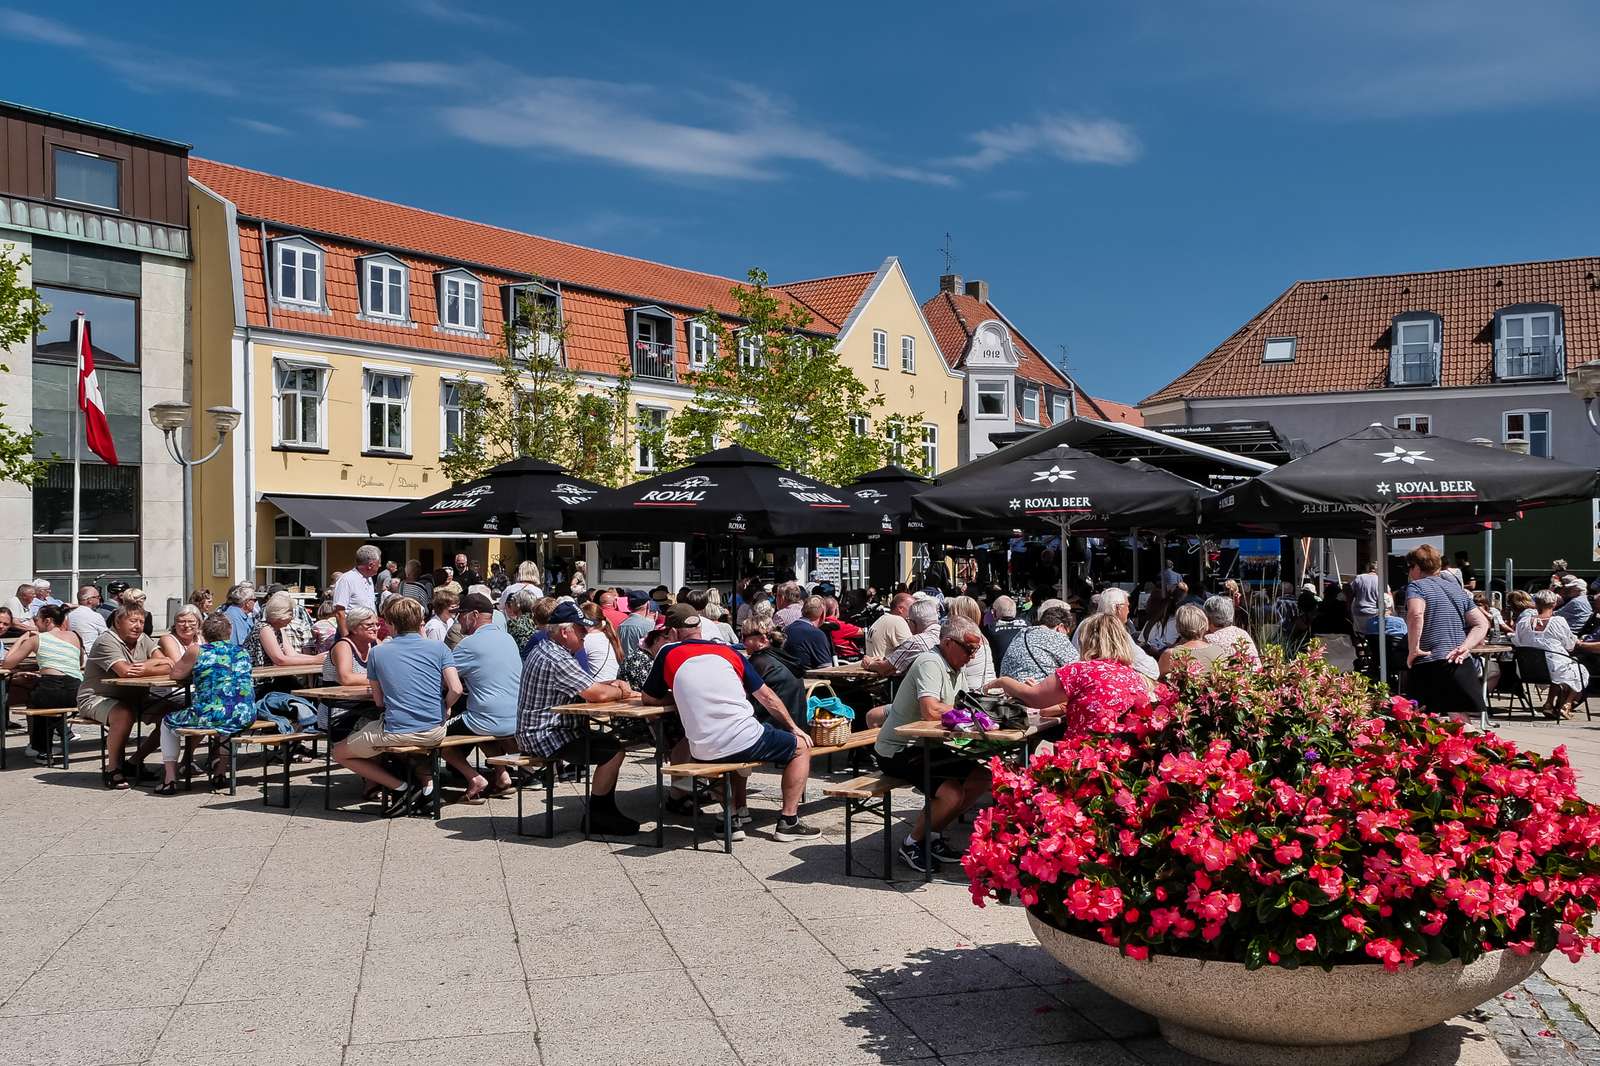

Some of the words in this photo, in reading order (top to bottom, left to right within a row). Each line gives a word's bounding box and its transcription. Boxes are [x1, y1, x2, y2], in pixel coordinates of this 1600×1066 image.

[983, 349, 1000, 359] 1912
[1395, 481, 1439, 493] ROYAL
[1440, 480, 1476, 492] BEER
[640, 490, 707, 501] ROYAL
[429, 498, 482, 509] ROYAL
[1024, 498, 1060, 508] ROYAL
[1062, 497, 1092, 507] BEER
[728, 522, 746, 530] ROYAL
